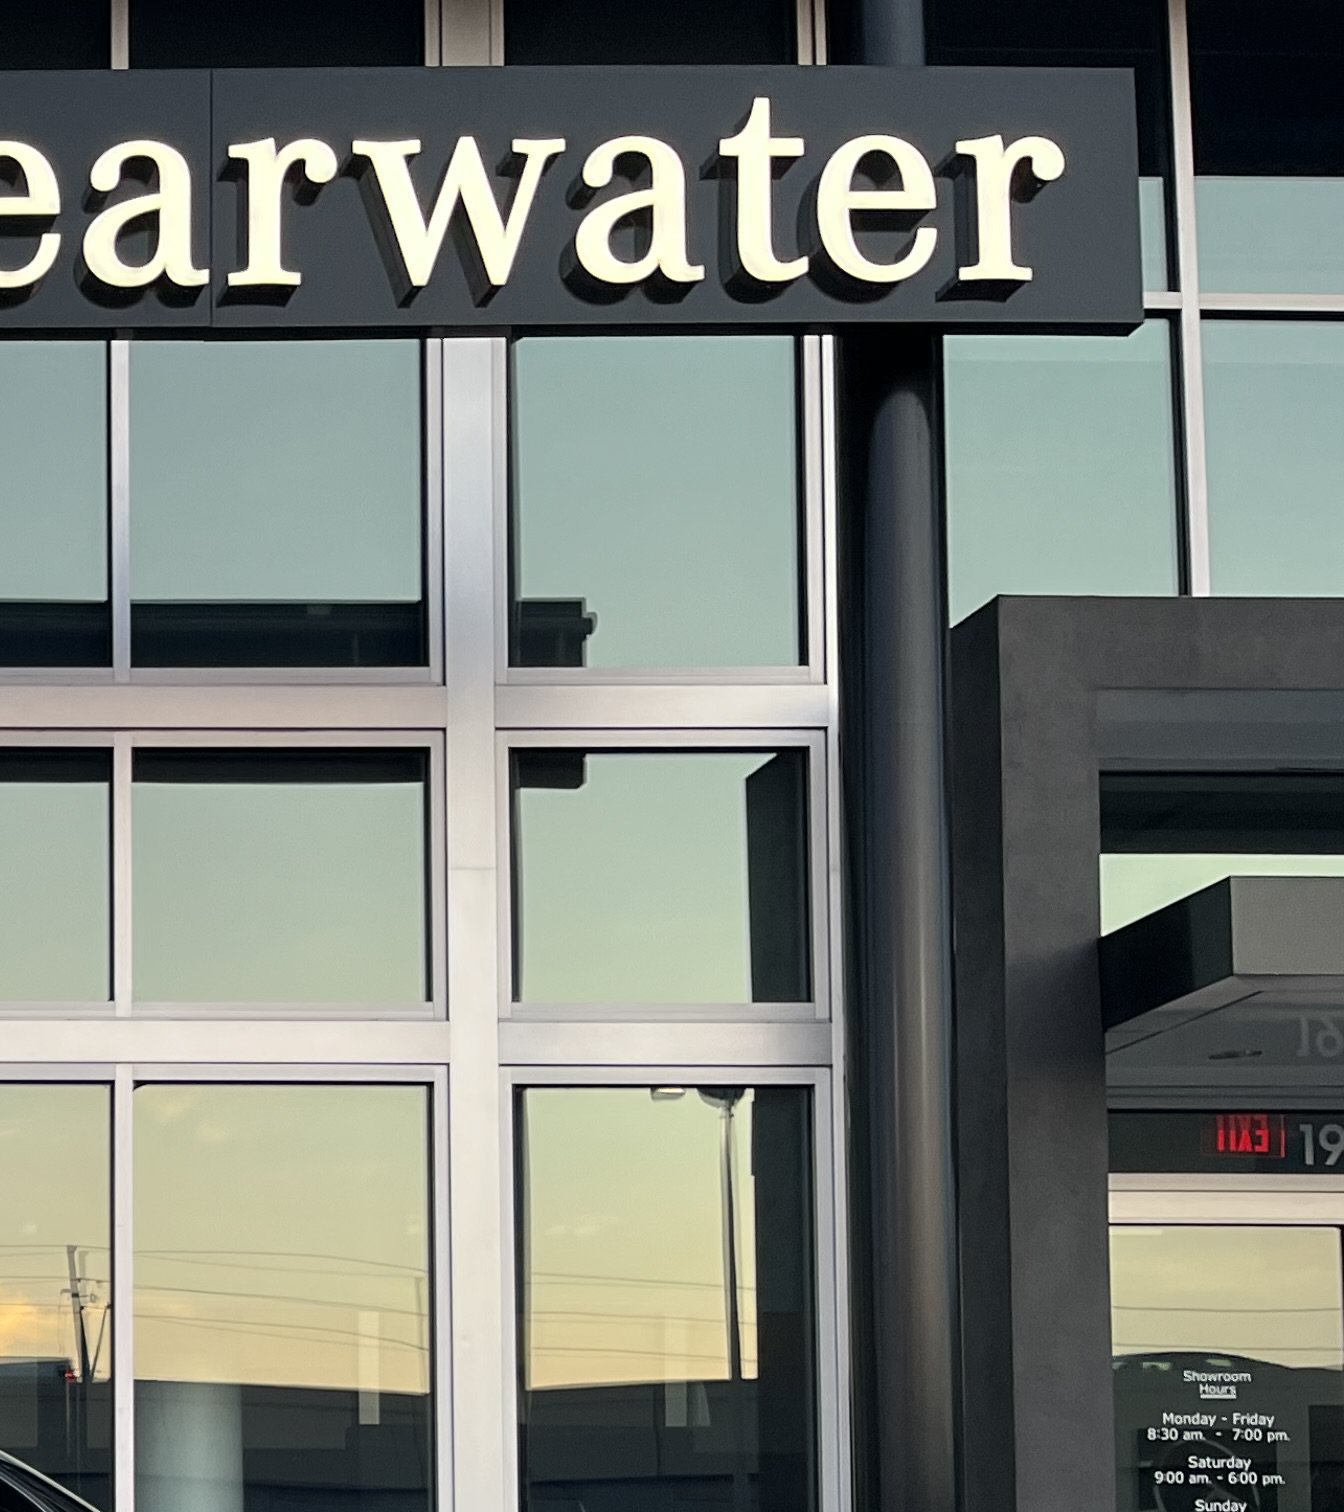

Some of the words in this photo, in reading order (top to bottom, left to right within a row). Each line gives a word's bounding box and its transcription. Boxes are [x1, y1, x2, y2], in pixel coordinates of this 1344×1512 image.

[1299, 1123, 1344, 1165] 19
[1183, 1370, 1252, 1383] Showroom
[1199, 1384, 1237, 1396] Hours
[1162, 1412, 1217, 1427] Monday
[1232, 1412, 1275, 1428] Friday
[1147, 1428, 1179, 1441] 8:30
[1182, 1431, 1206, 1441] am.
[1232, 1428, 1263, 1441] 7:00
[1266, 1431, 1291, 1443] pm.
[1188, 1455, 1252, 1471] Saturday
[1154, 1471, 1184, 1484] 9:00
[1188, 1475, 1212, 1484] am.
[1227, 1471, 1258, 1485] 6:00
[1261, 1475, 1286, 1487] pm.
